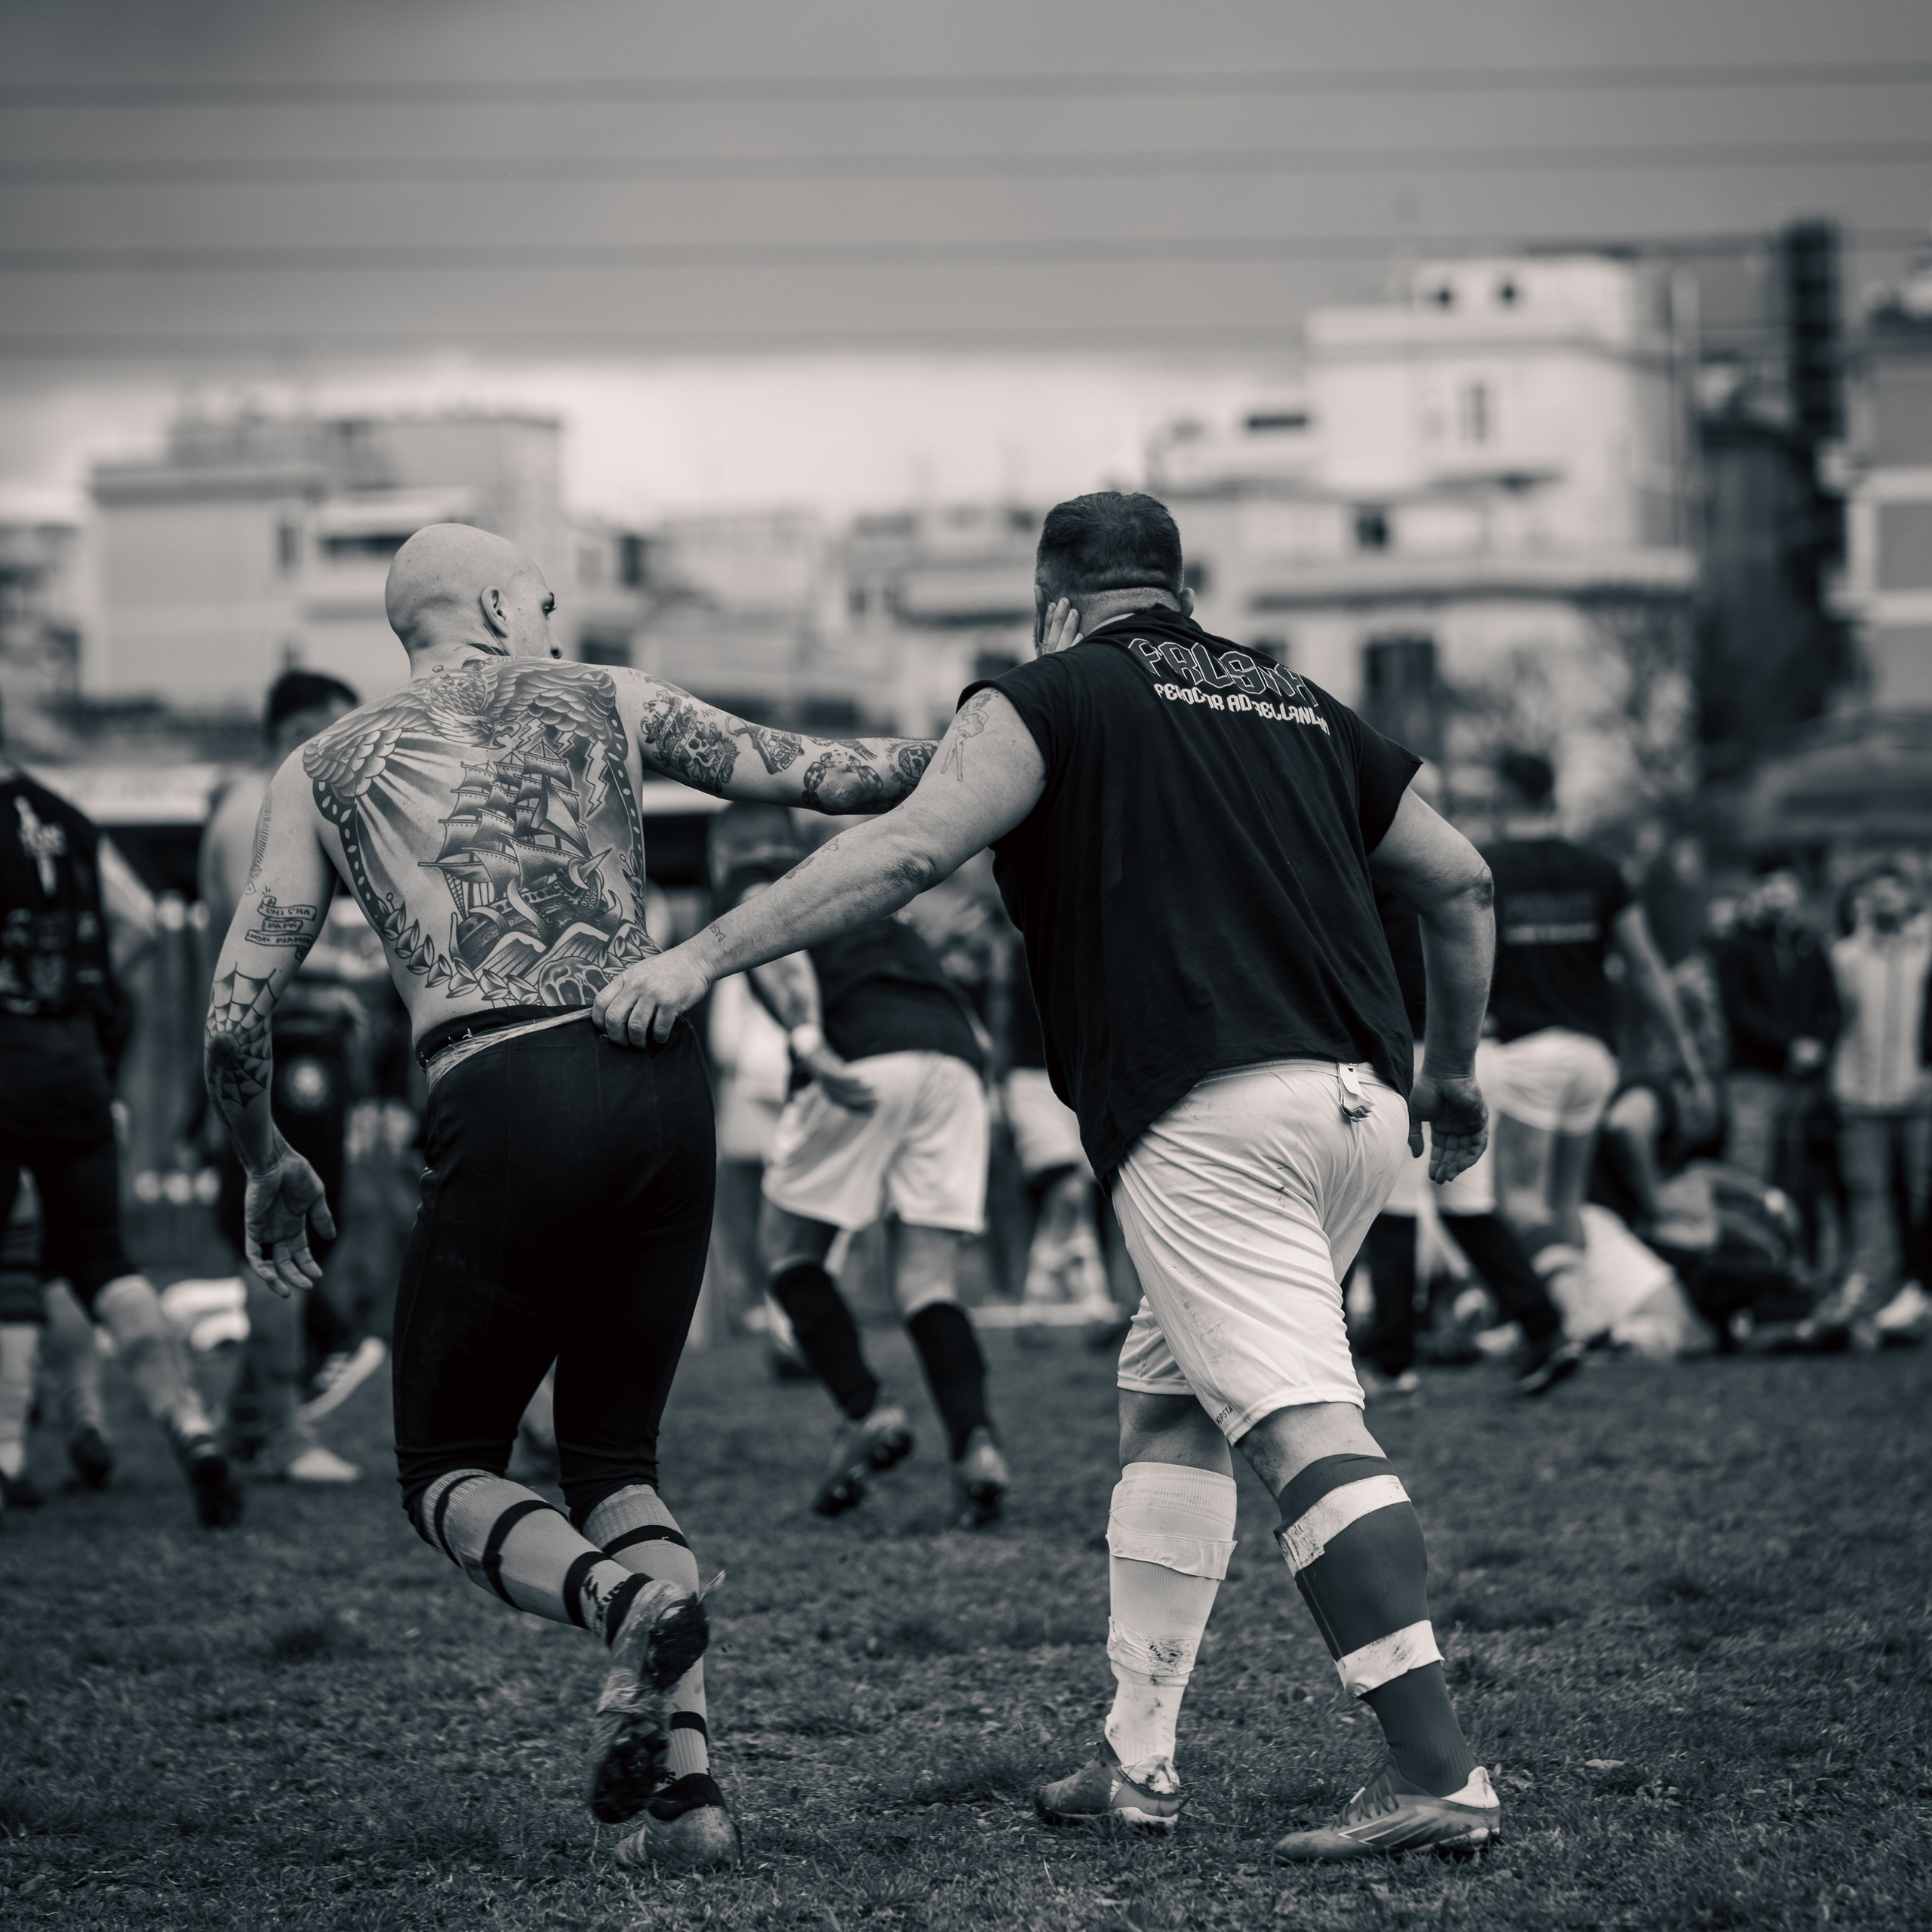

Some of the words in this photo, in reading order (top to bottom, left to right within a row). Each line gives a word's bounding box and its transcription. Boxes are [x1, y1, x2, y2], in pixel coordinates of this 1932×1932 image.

[1226, 694, 1253, 712] AD
[671, 743, 685, 764] LIVE
[1215, 1404, 1234, 1425] KIPSTA
